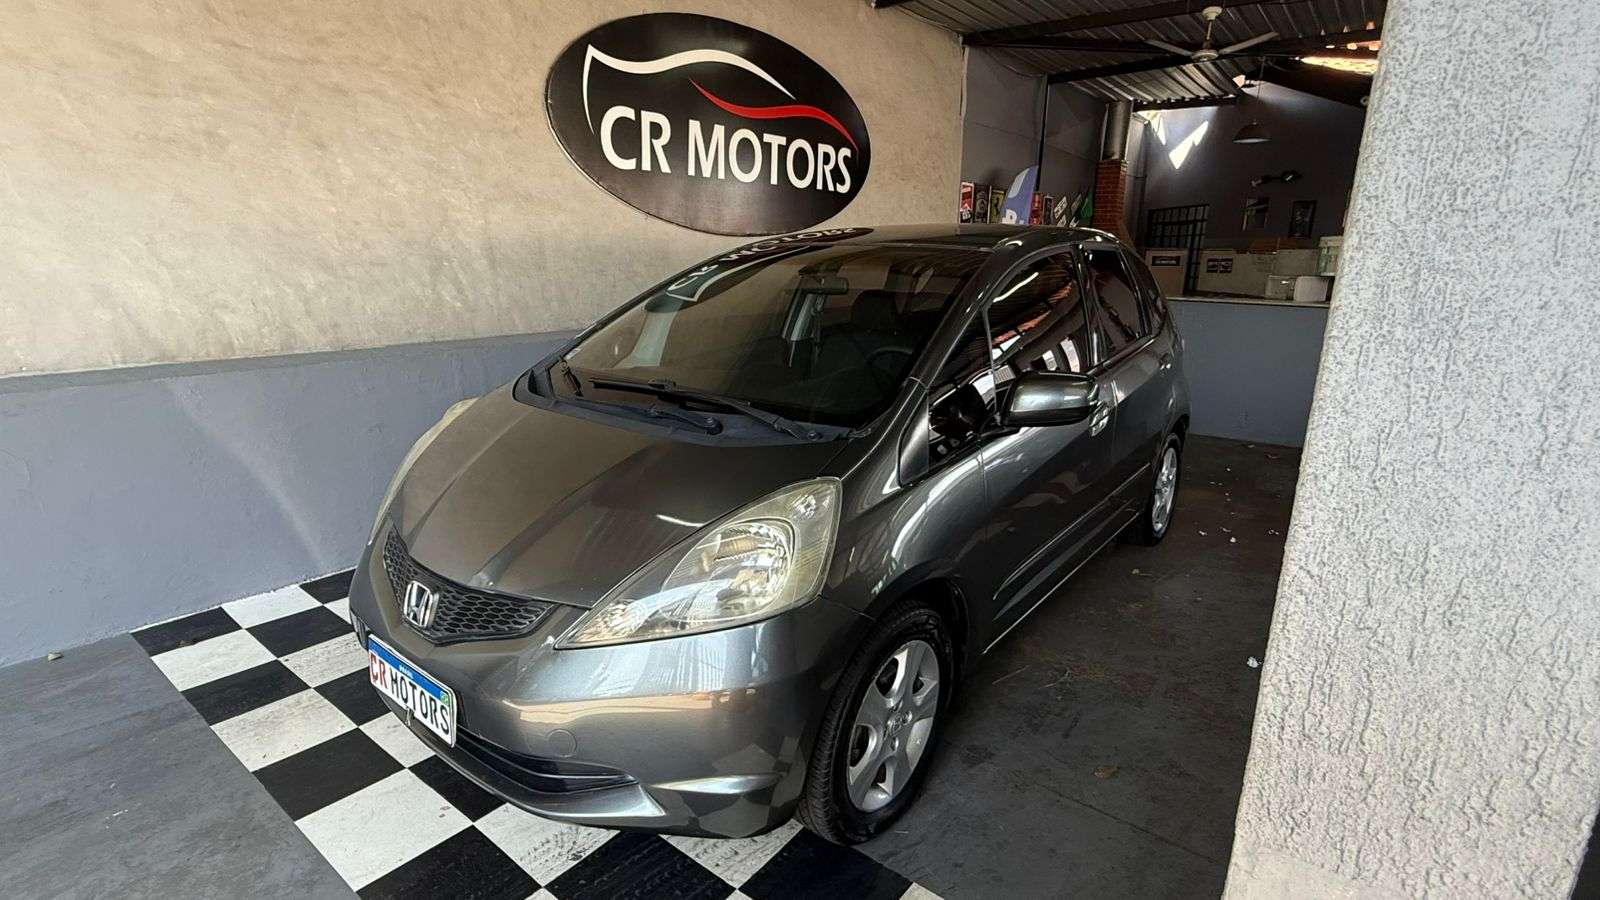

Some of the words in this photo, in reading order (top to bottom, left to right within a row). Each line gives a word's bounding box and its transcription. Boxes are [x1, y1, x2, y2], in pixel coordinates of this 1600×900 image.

[600, 105, 672, 174] CR
[687, 118, 851, 194] MOTORS
[369, 653, 388, 689] CR
[389, 668, 450, 735] MOTORS
